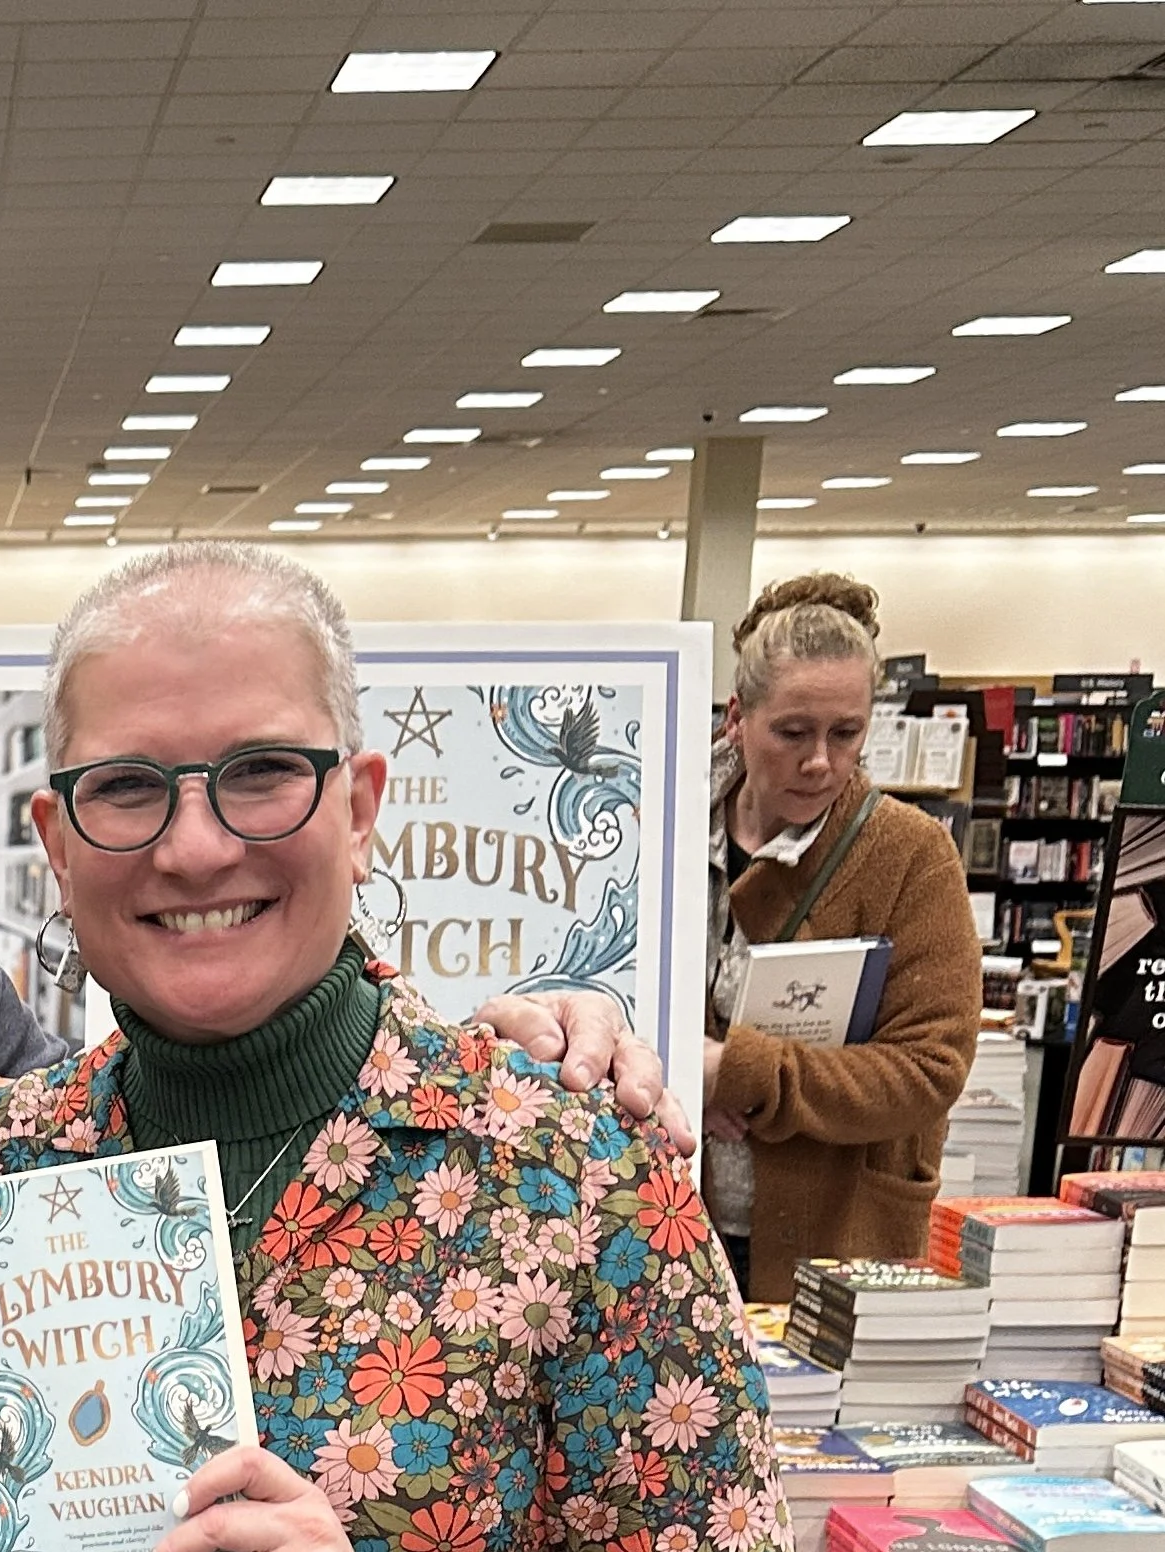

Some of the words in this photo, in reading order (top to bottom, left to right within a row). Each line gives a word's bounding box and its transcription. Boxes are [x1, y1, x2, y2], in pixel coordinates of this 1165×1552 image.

[386, 776, 448, 804] THE
[366, 821, 594, 914] MBURY
[399, 917, 525, 978] TCH
[45, 1231, 89, 1255] THE
[2, 1316, 156, 1369] WITCH
[55, 1463, 154, 1491] KENDRA
[48, 1493, 166, 1522] VAUGHAN
